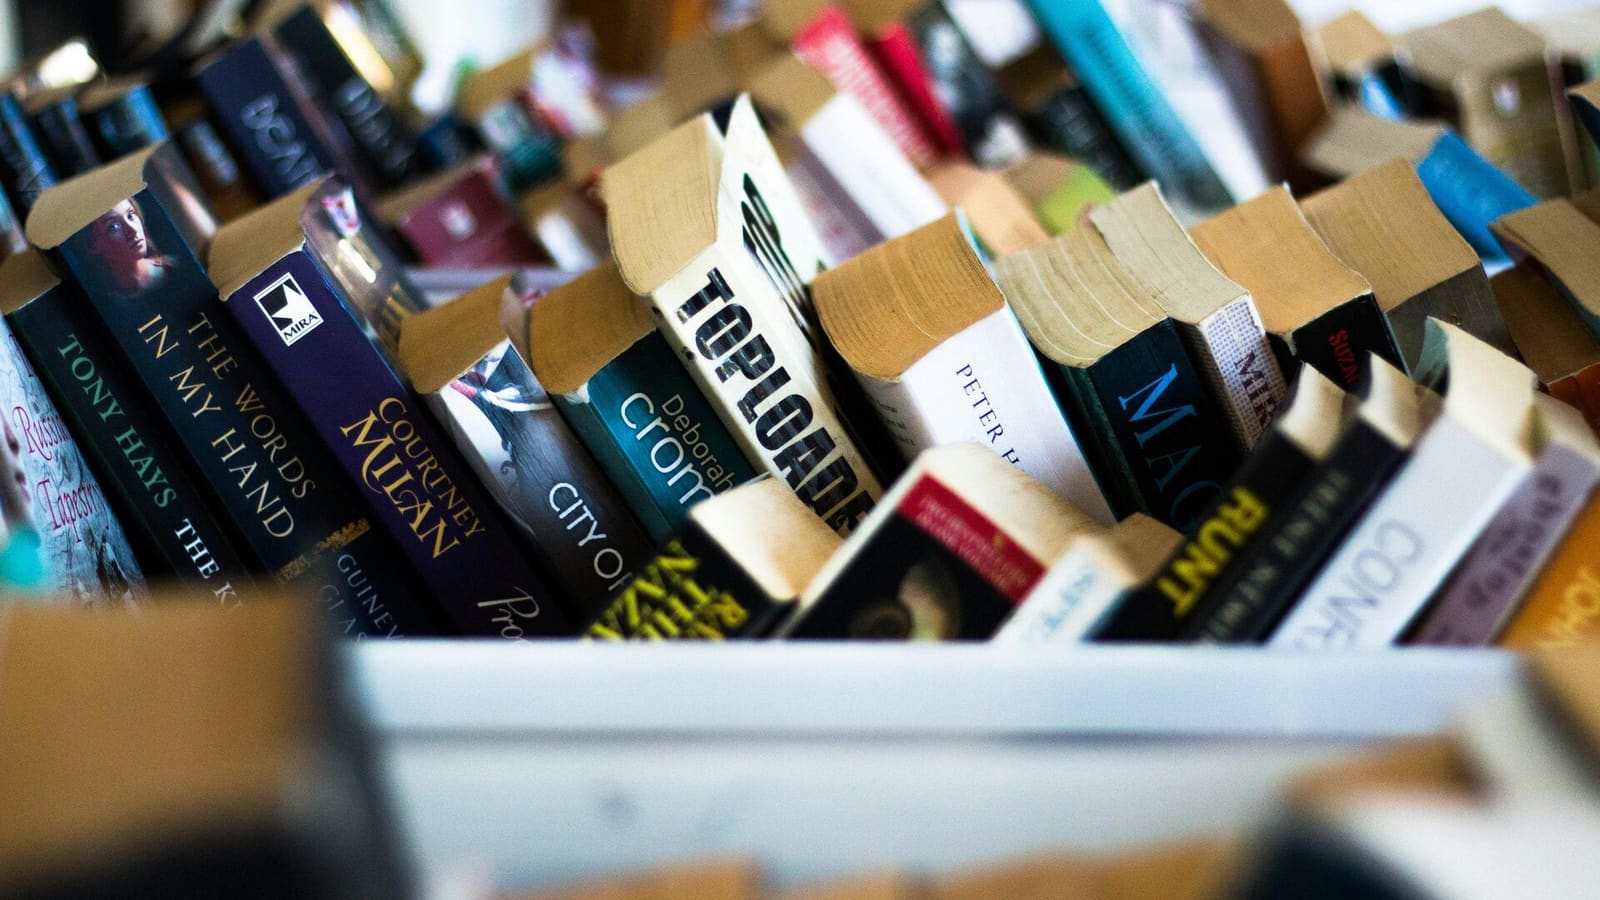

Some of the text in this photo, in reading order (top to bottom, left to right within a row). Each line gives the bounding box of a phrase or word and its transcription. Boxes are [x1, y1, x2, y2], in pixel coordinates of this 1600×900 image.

[282, 312, 318, 341] MIRA
[57, 334, 125, 423] TONY
[114, 425, 177, 508] HAYS
[174, 518, 220, 580] THE
[137, 313, 295, 538] IN MY HAND
[187, 312, 316, 499] THE WORDS
[378, 396, 487, 539] COURTNEY
[661, 393, 736, 493] Deborah
[955, 363, 1004, 444] PETER
[340, 409, 460, 559] MILAN
[549, 482, 608, 547] CITY
[1156, 485, 1269, 618] RUNT
